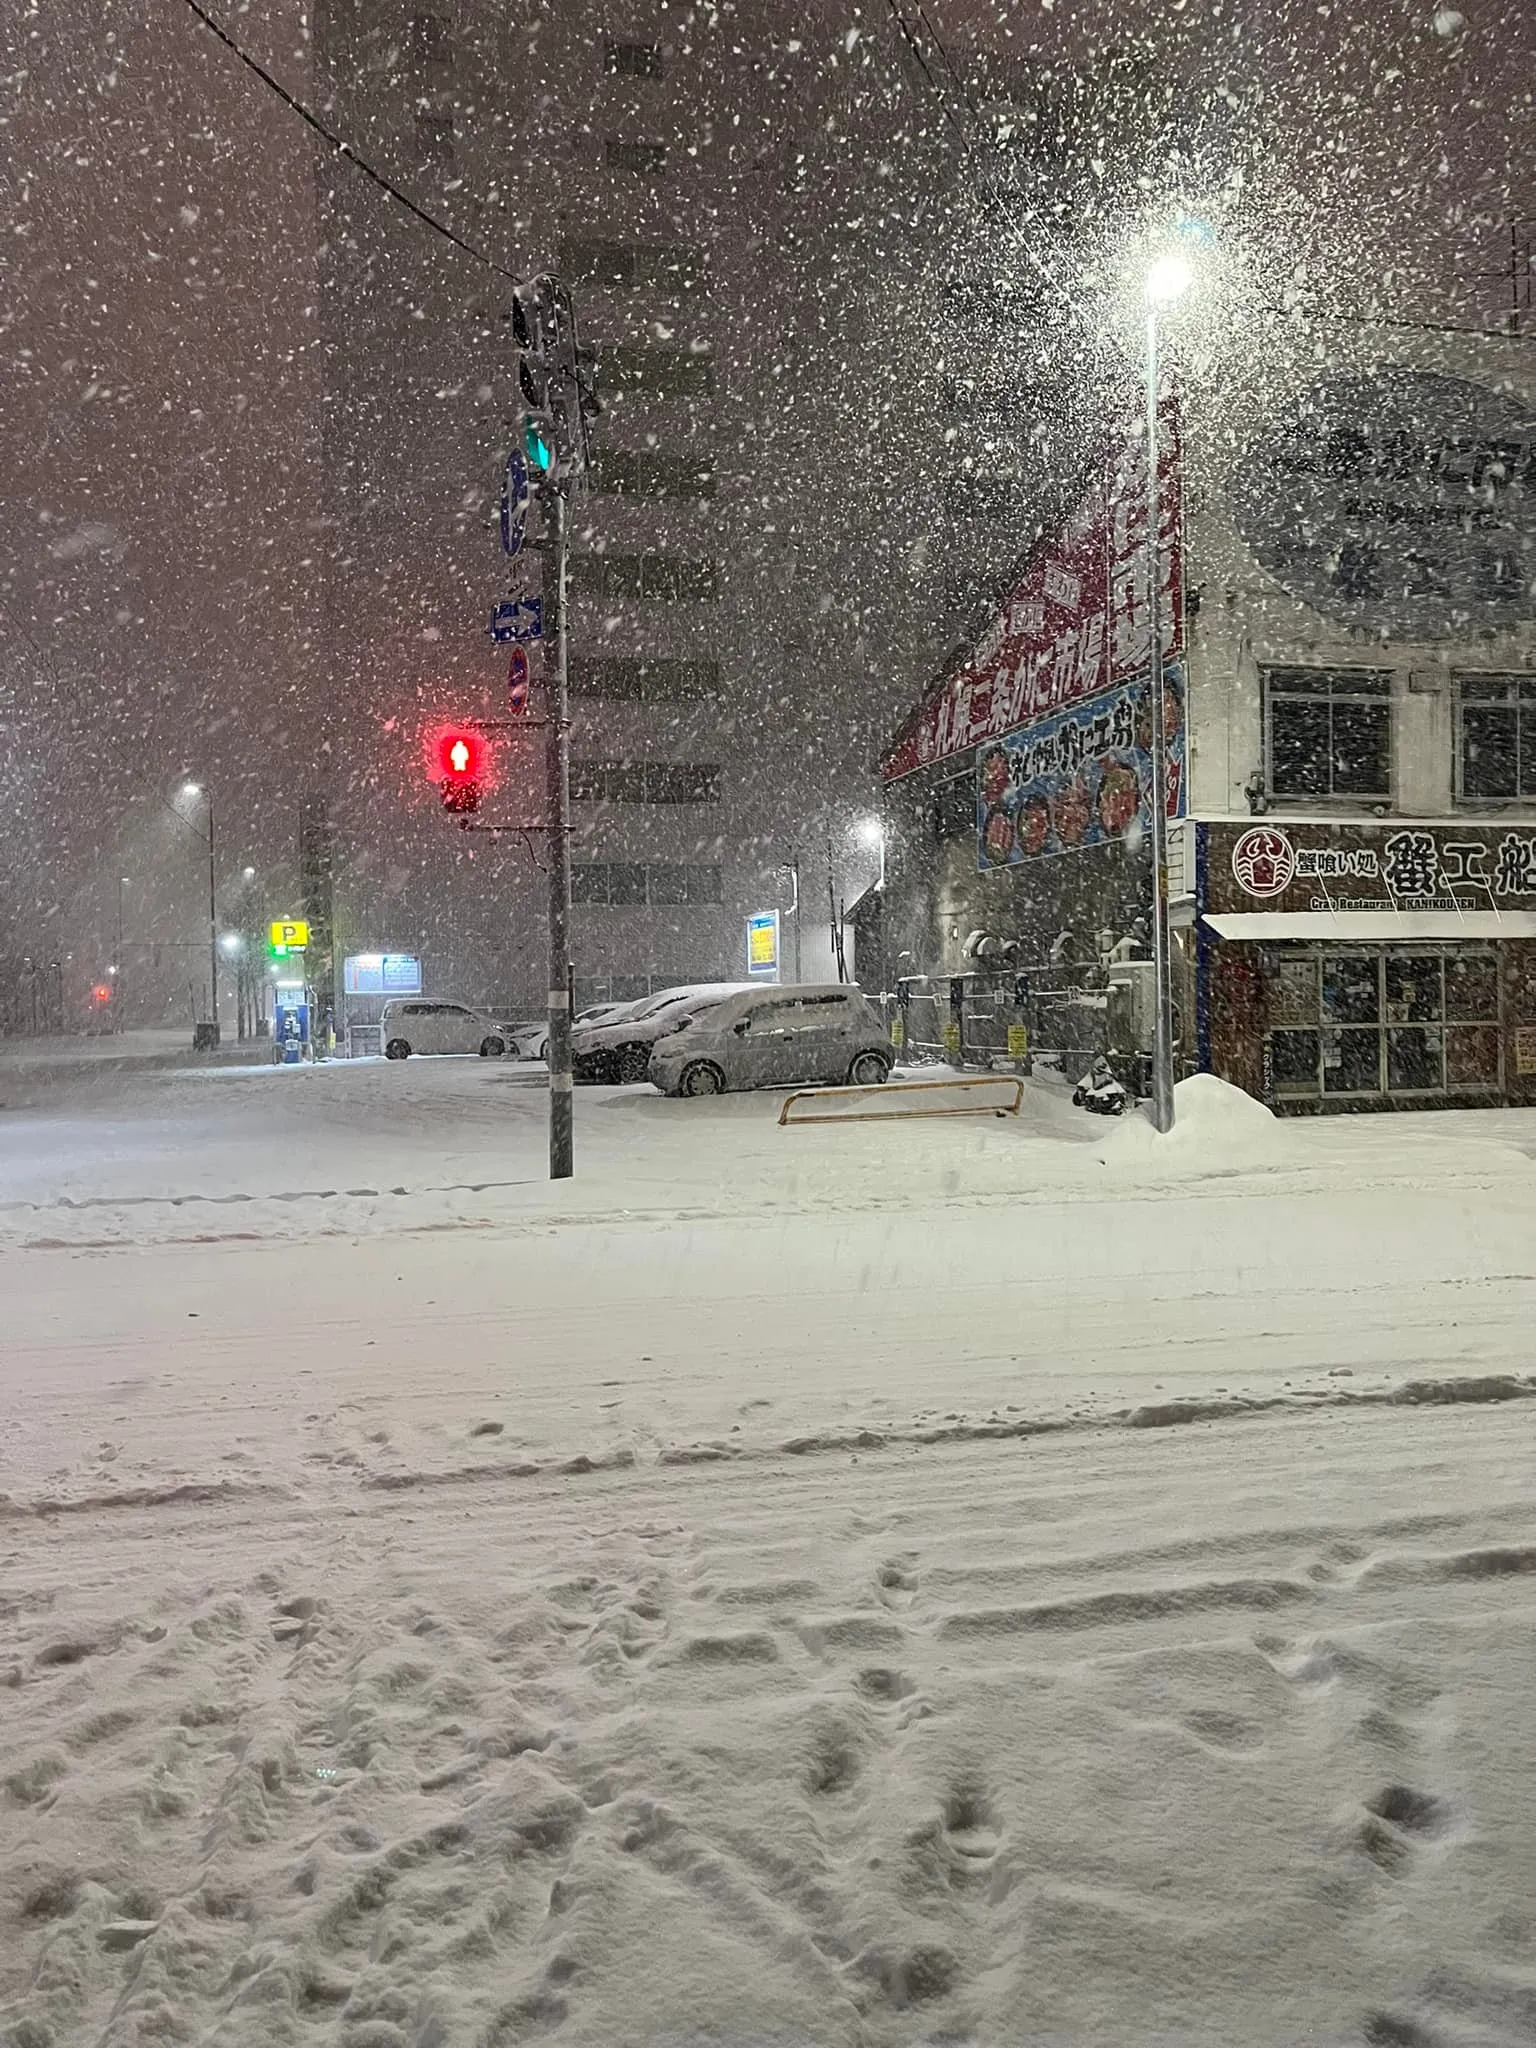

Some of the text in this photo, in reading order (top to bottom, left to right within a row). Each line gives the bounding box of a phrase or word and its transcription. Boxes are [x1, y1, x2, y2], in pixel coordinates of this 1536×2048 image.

[1296, 850, 1377, 876] 蟹喰い処
[282, 926, 296, 941] P
